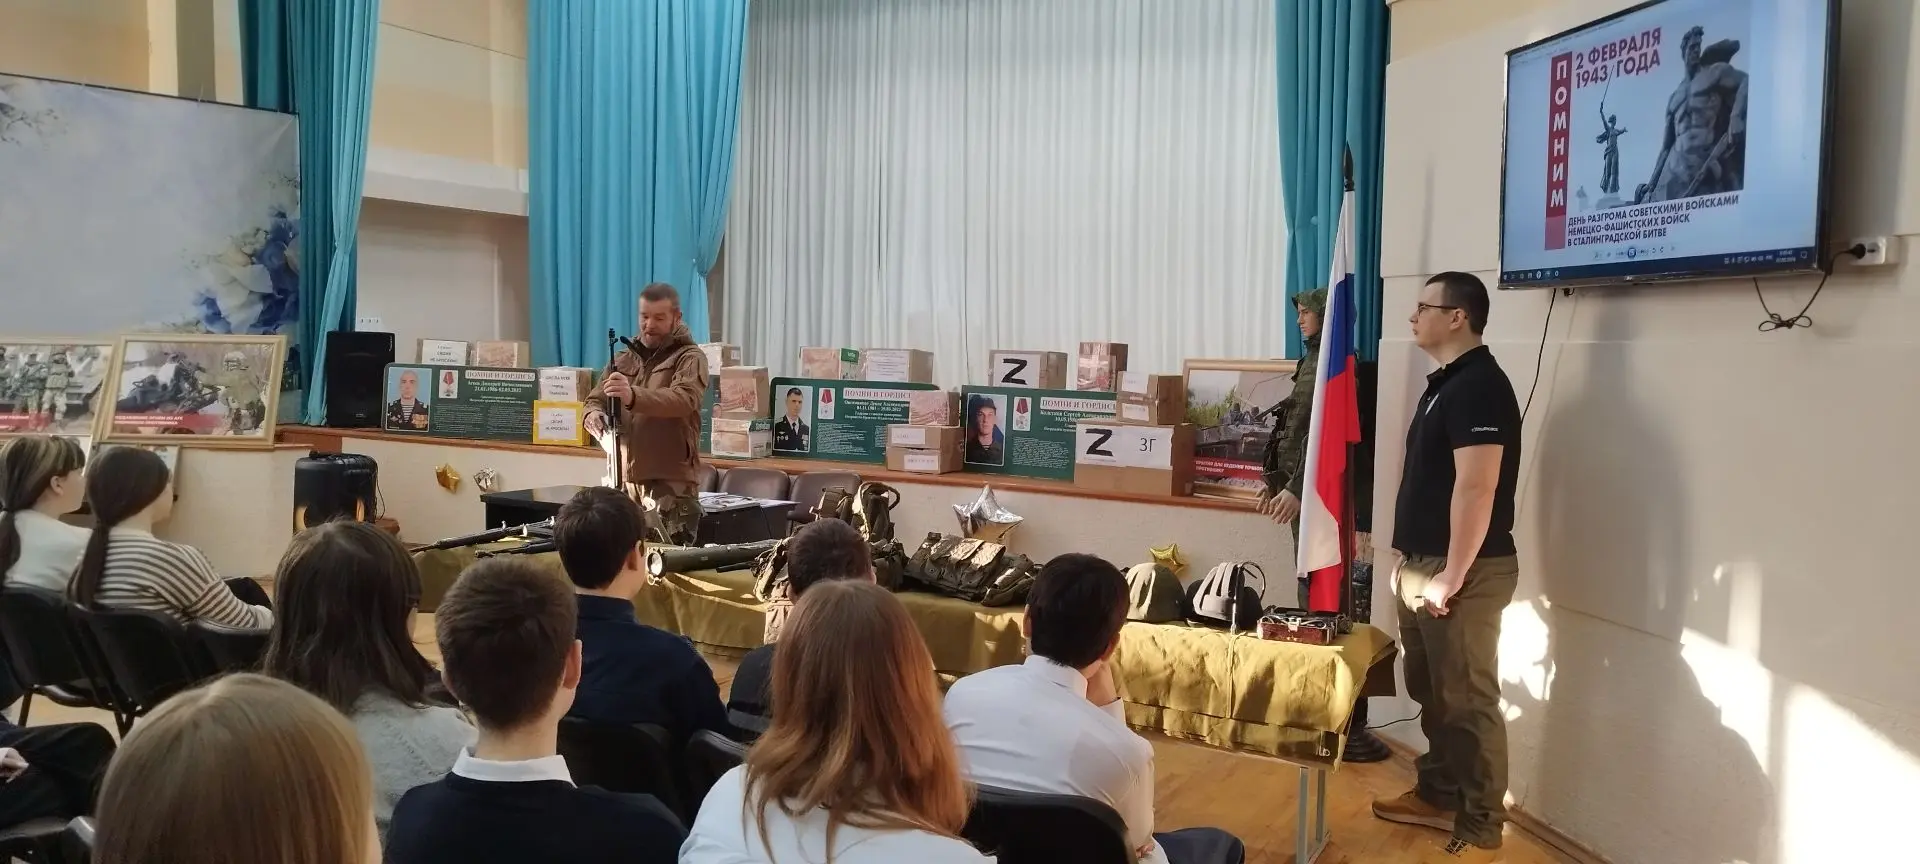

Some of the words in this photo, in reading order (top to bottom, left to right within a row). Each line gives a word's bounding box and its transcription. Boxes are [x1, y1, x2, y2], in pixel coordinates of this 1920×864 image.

[1575, 53, 1584, 70] 2
[1588, 27, 1661, 65] ФЕВРАЛЯ
[1576, 64, 1608, 88] 1943
[1616, 49, 1660, 77] ГОДА
[1551, 60, 1567, 207] ПОМНИМ
[1568, 216, 1586, 228] ДЕНЬ
[1588, 210, 1627, 224] РАЗГРОМА
[1628, 201, 1684, 218] СОВЕТСКИМИ
[1686, 194, 1739, 211] ВОЙСКАМИ
[1568, 216, 1659, 236] НЕМЕЦКО-ФАШИСТСКИХ
[1661, 212, 1690, 226] ВОЙСК
[1567, 238, 1572, 247] В
[1573, 228, 1641, 246] СТАЛИНГРАДСКОЙ
[1643, 227, 1667, 239] БИТВЕ
[1001, 358, 1027, 385] Z
[1042, 400, 1072, 408] ПОМНИ
[1085, 428, 1113, 456] Z
